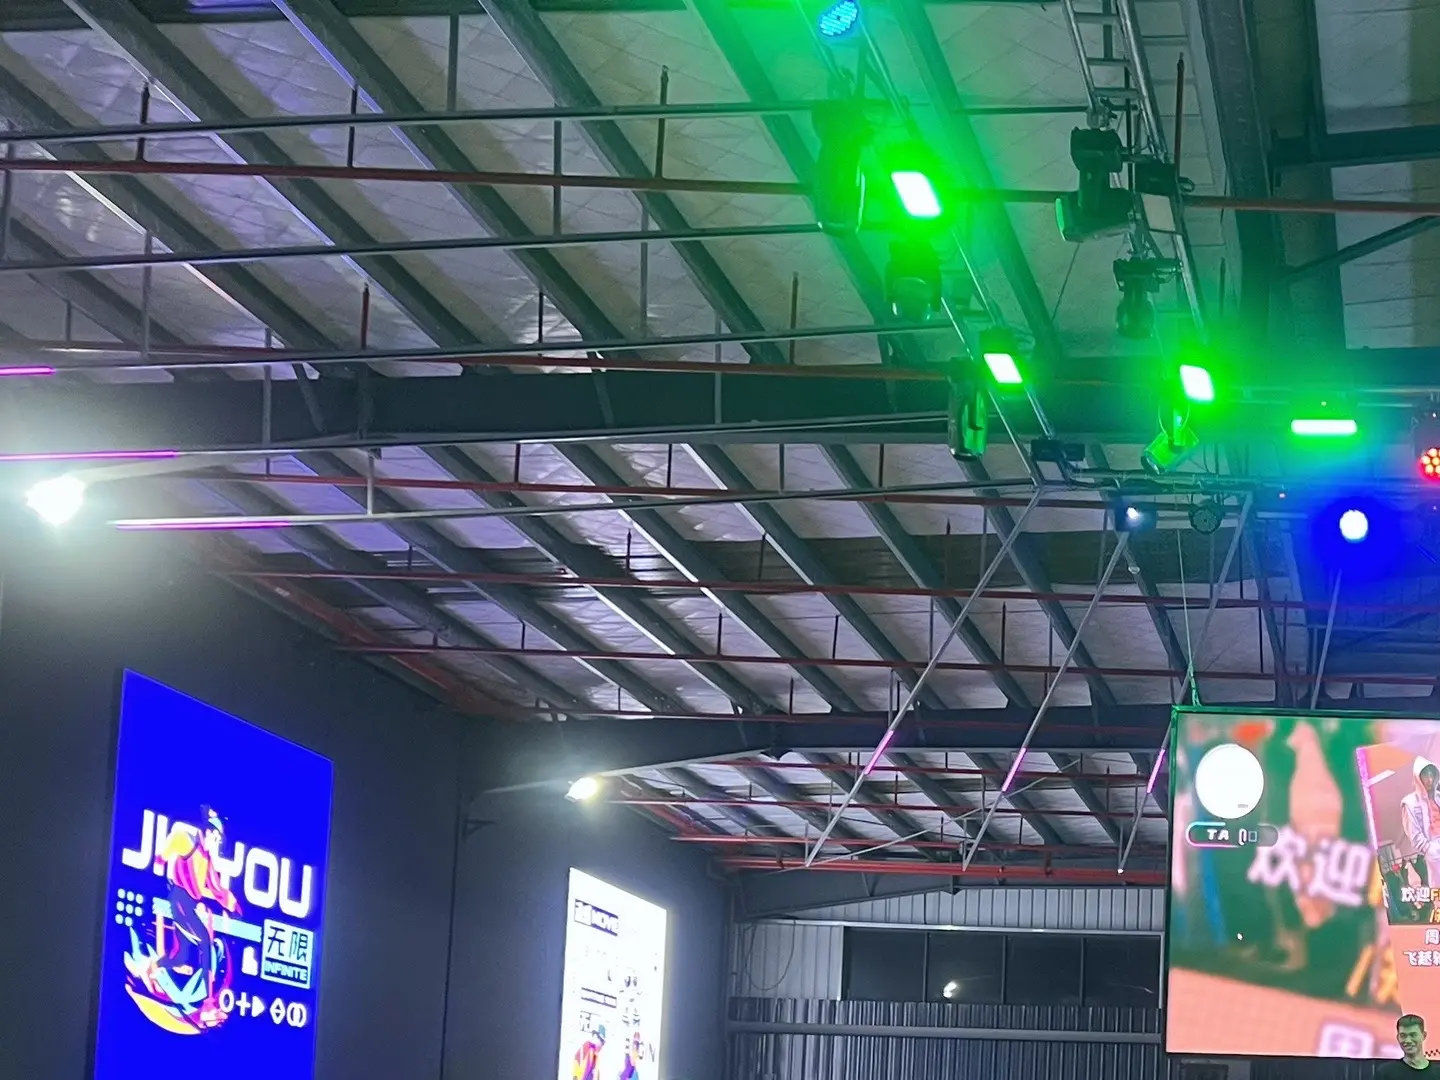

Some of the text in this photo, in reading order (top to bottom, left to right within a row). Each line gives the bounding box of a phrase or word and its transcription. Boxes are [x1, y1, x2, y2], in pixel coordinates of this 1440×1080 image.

[122, 809, 313, 919] JIYOU
[267, 925, 309, 962] 无限
[264, 959, 308, 983] INFINITE
